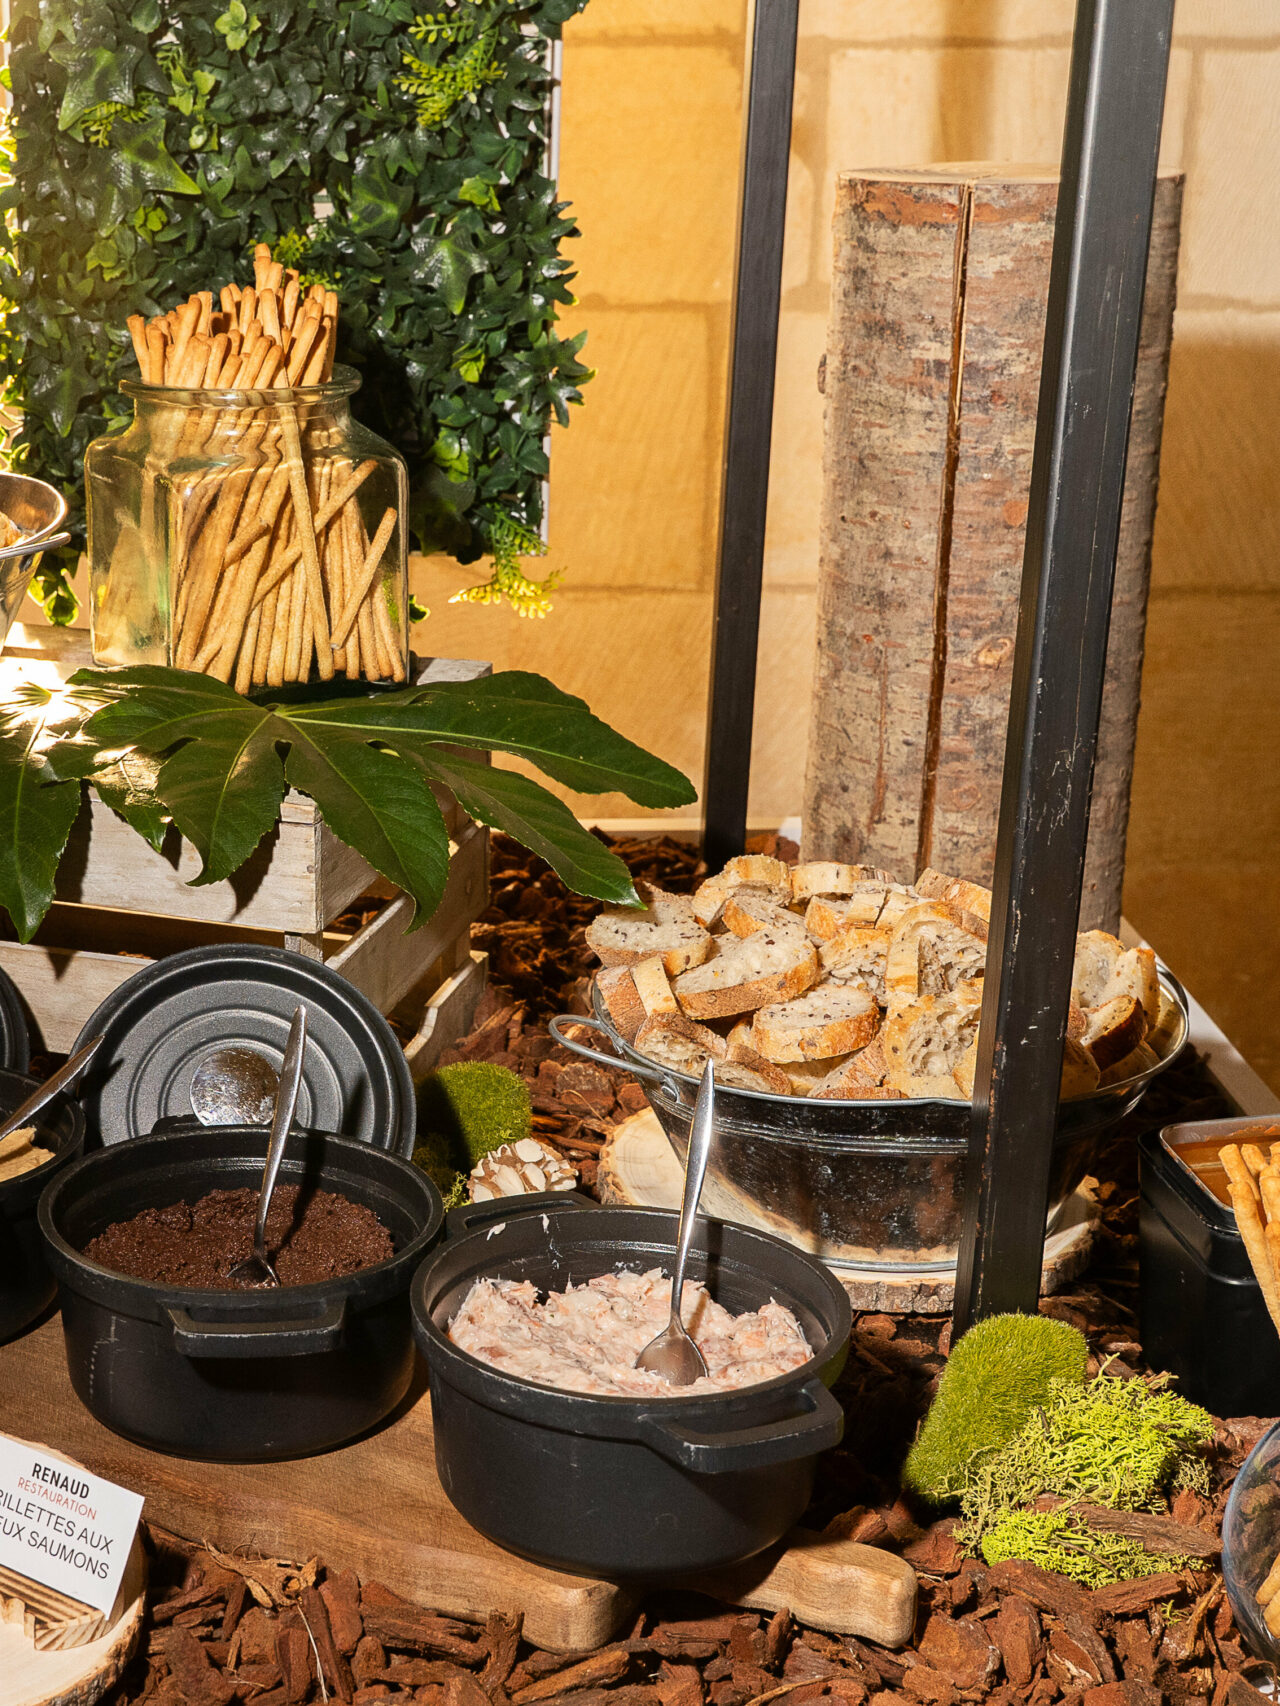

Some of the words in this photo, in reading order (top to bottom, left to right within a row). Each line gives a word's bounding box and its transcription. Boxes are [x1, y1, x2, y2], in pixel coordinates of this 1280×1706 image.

[17, 1477, 98, 1521] RESTAURATION
[31, 1463, 90, 1499] RENAUD
[26, 1529, 110, 1579] SAUMONS
[76, 1522, 115, 1556] AUX
